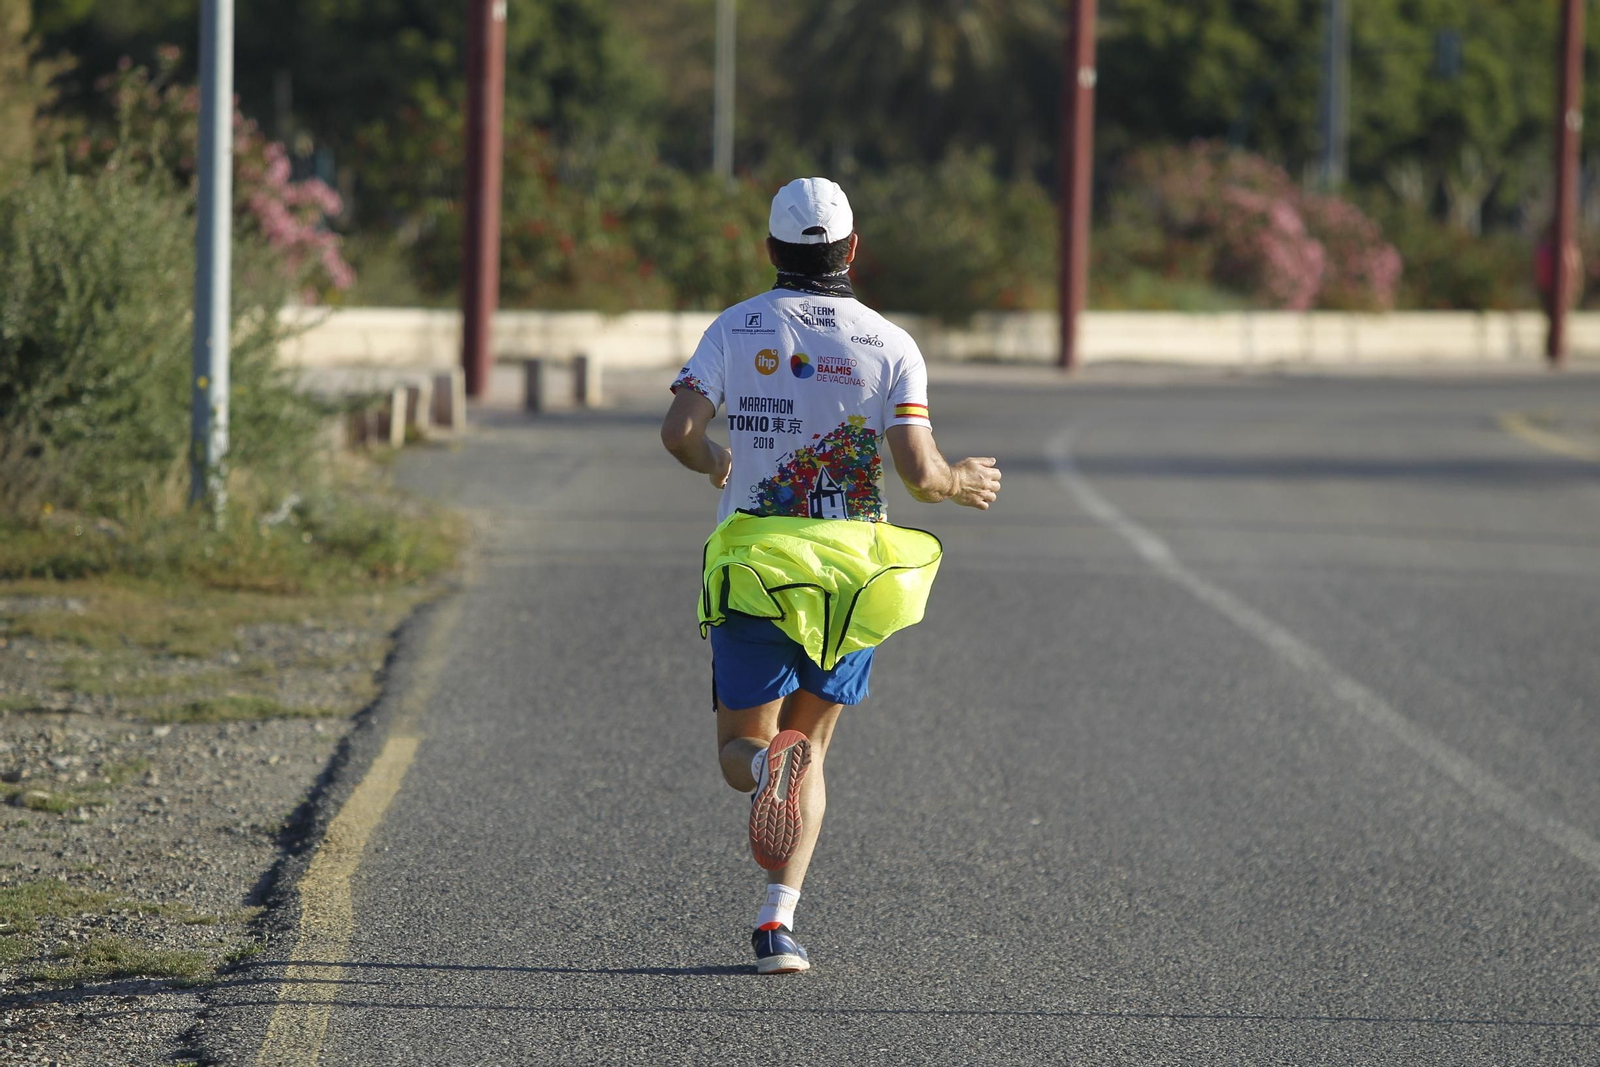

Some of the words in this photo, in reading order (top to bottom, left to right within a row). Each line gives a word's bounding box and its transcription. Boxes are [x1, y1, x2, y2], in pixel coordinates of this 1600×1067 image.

[812, 306, 835, 316] TEAM
[758, 355, 777, 370] ihp
[817, 356, 857, 367] INSTITUTO
[817, 364, 852, 375] BALMIS
[816, 374, 828, 382] DE
[829, 375, 866, 387] VACUNAS
[739, 396, 794, 414] MARATHON
[728, 415, 769, 433] TOKIO
[771, 417, 803, 434] 東京
[753, 436, 775, 449] 2018
